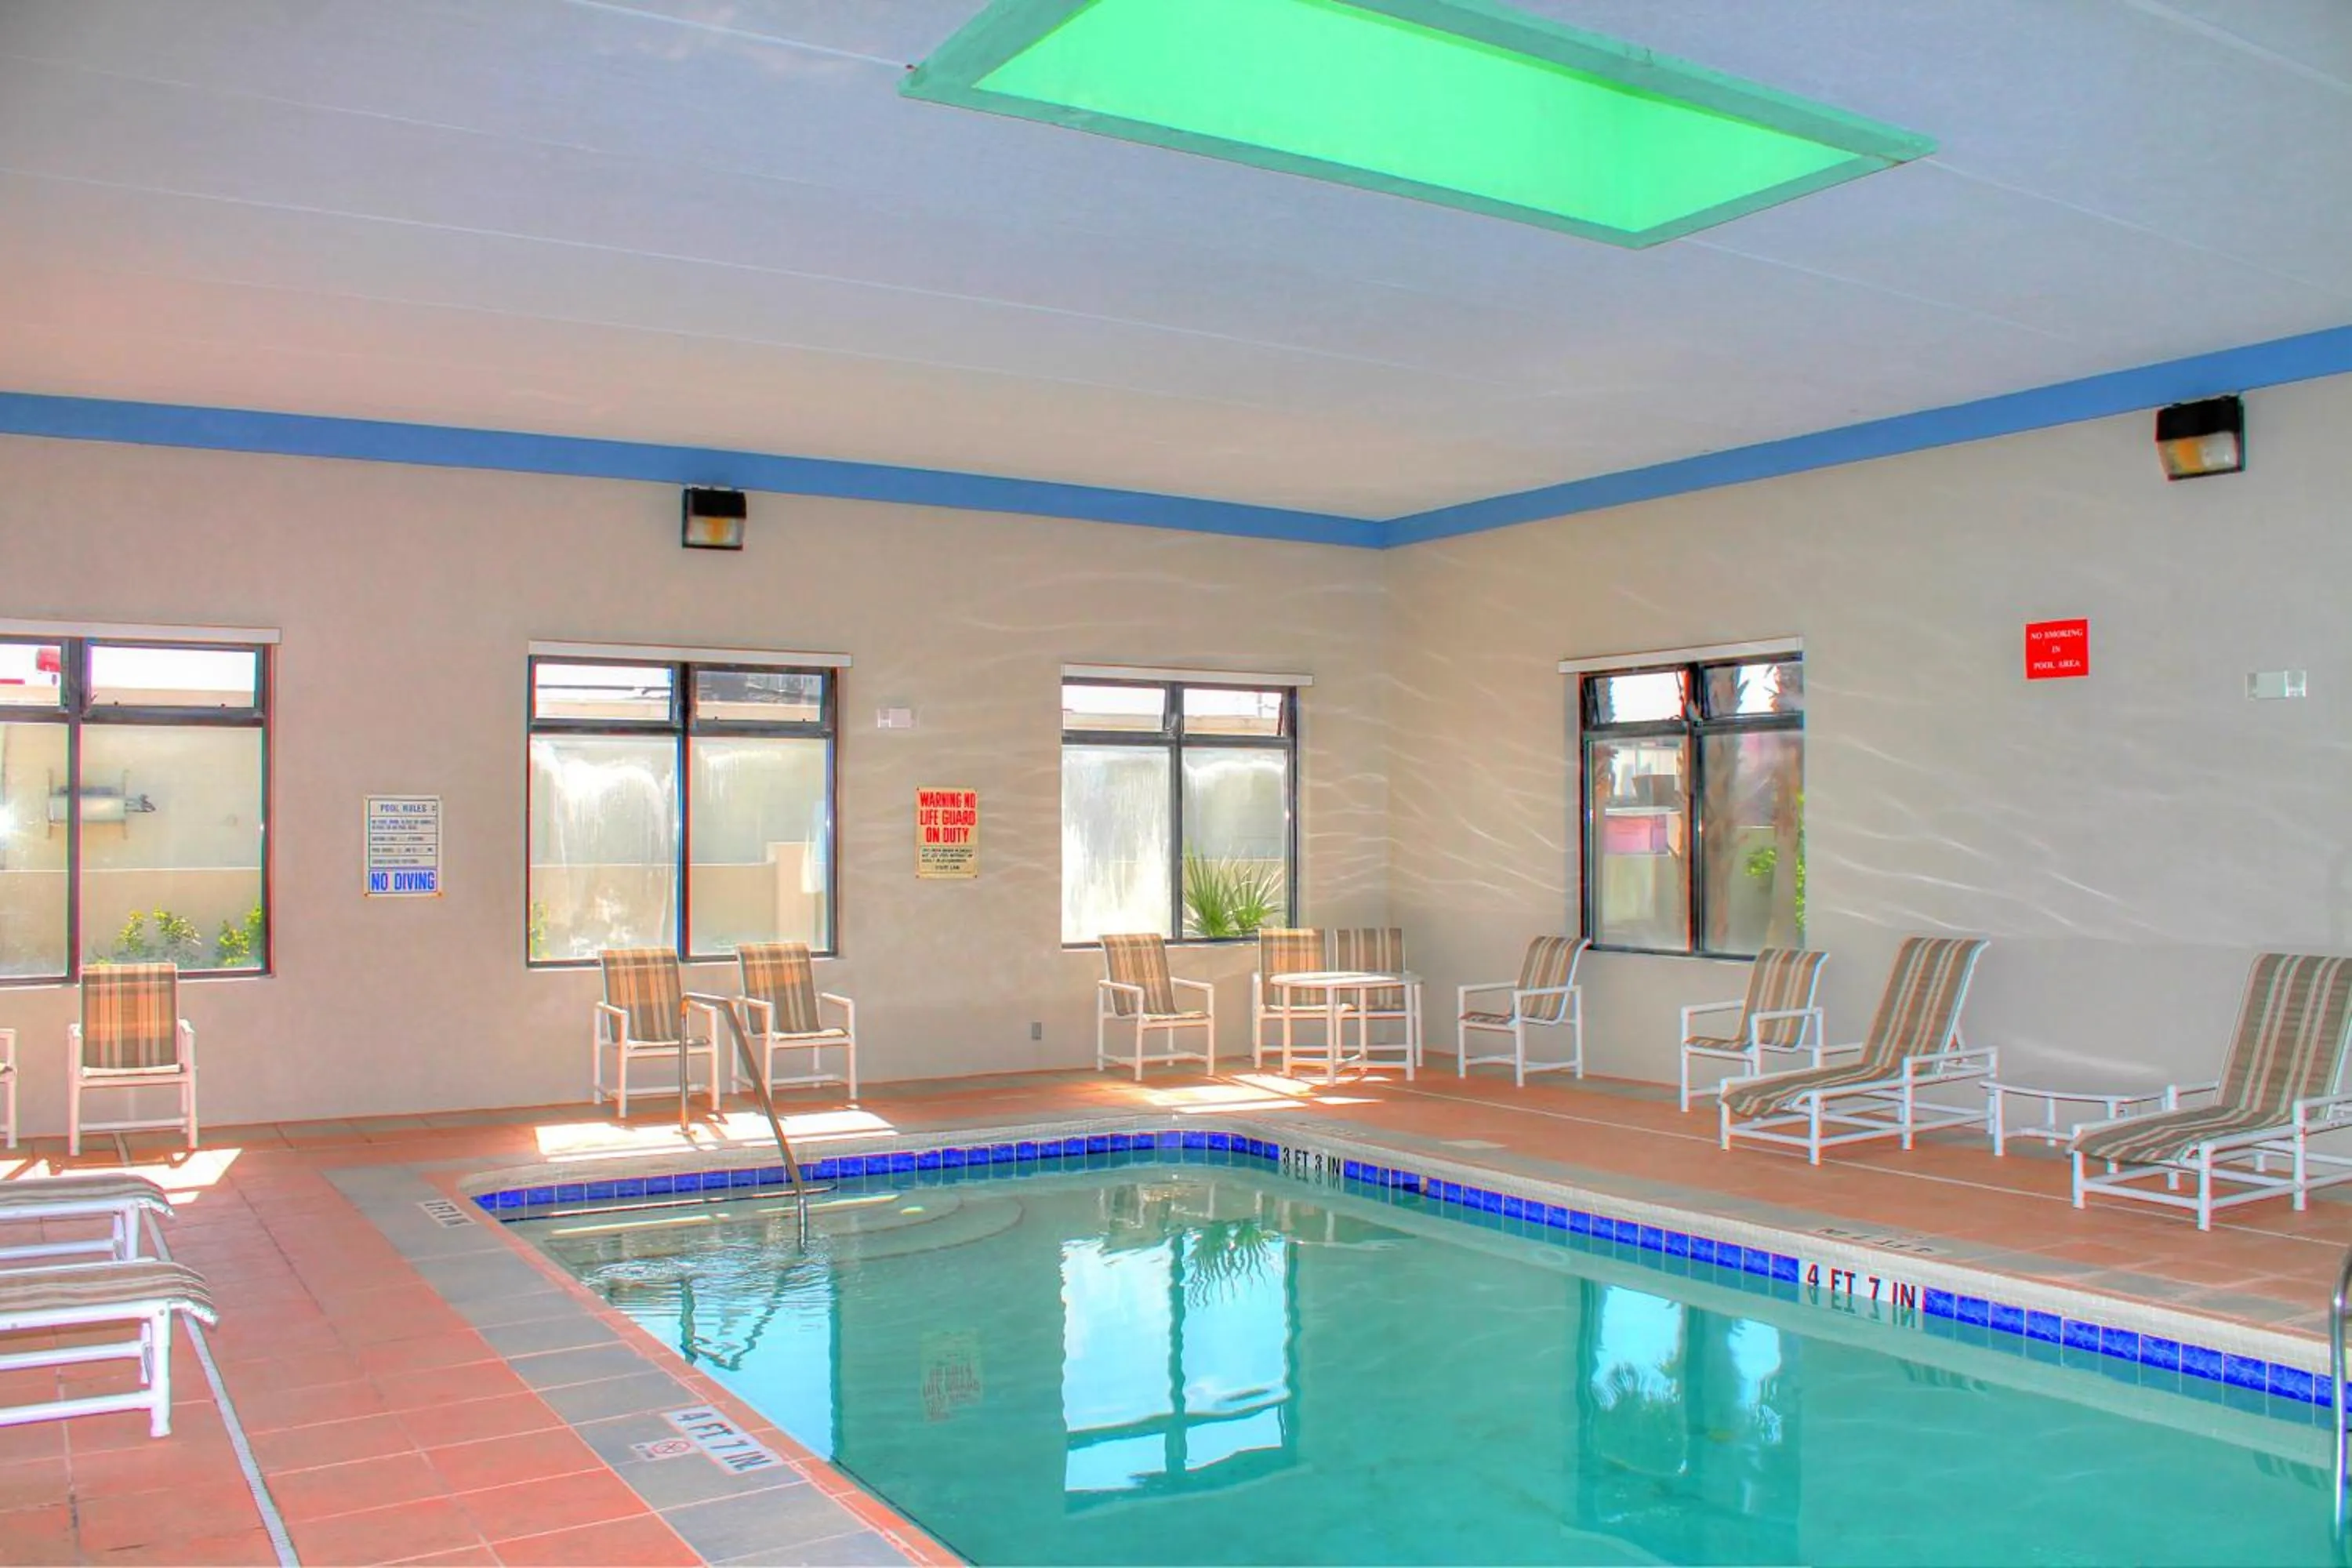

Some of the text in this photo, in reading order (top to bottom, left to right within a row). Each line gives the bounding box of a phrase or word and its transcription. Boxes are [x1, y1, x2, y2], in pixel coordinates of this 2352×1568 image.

[2031, 628, 2082, 640] NO SMOKING
[2033, 659, 2081, 670] POOL AREA
[920, 791, 975, 808] WARNING NO
[380, 804, 399, 813] POOL
[920, 809, 975, 826] LIFE GUARD
[926, 827, 970, 843] ON DUTY
[372, 872, 435, 891] NO DIVING
[1283, 1146, 1341, 1174] 3 FT 3 IN
[1807, 1263, 1915, 1308] 4 FT 7 IN
[677, 1412, 774, 1472] 4 FT 7 IN
